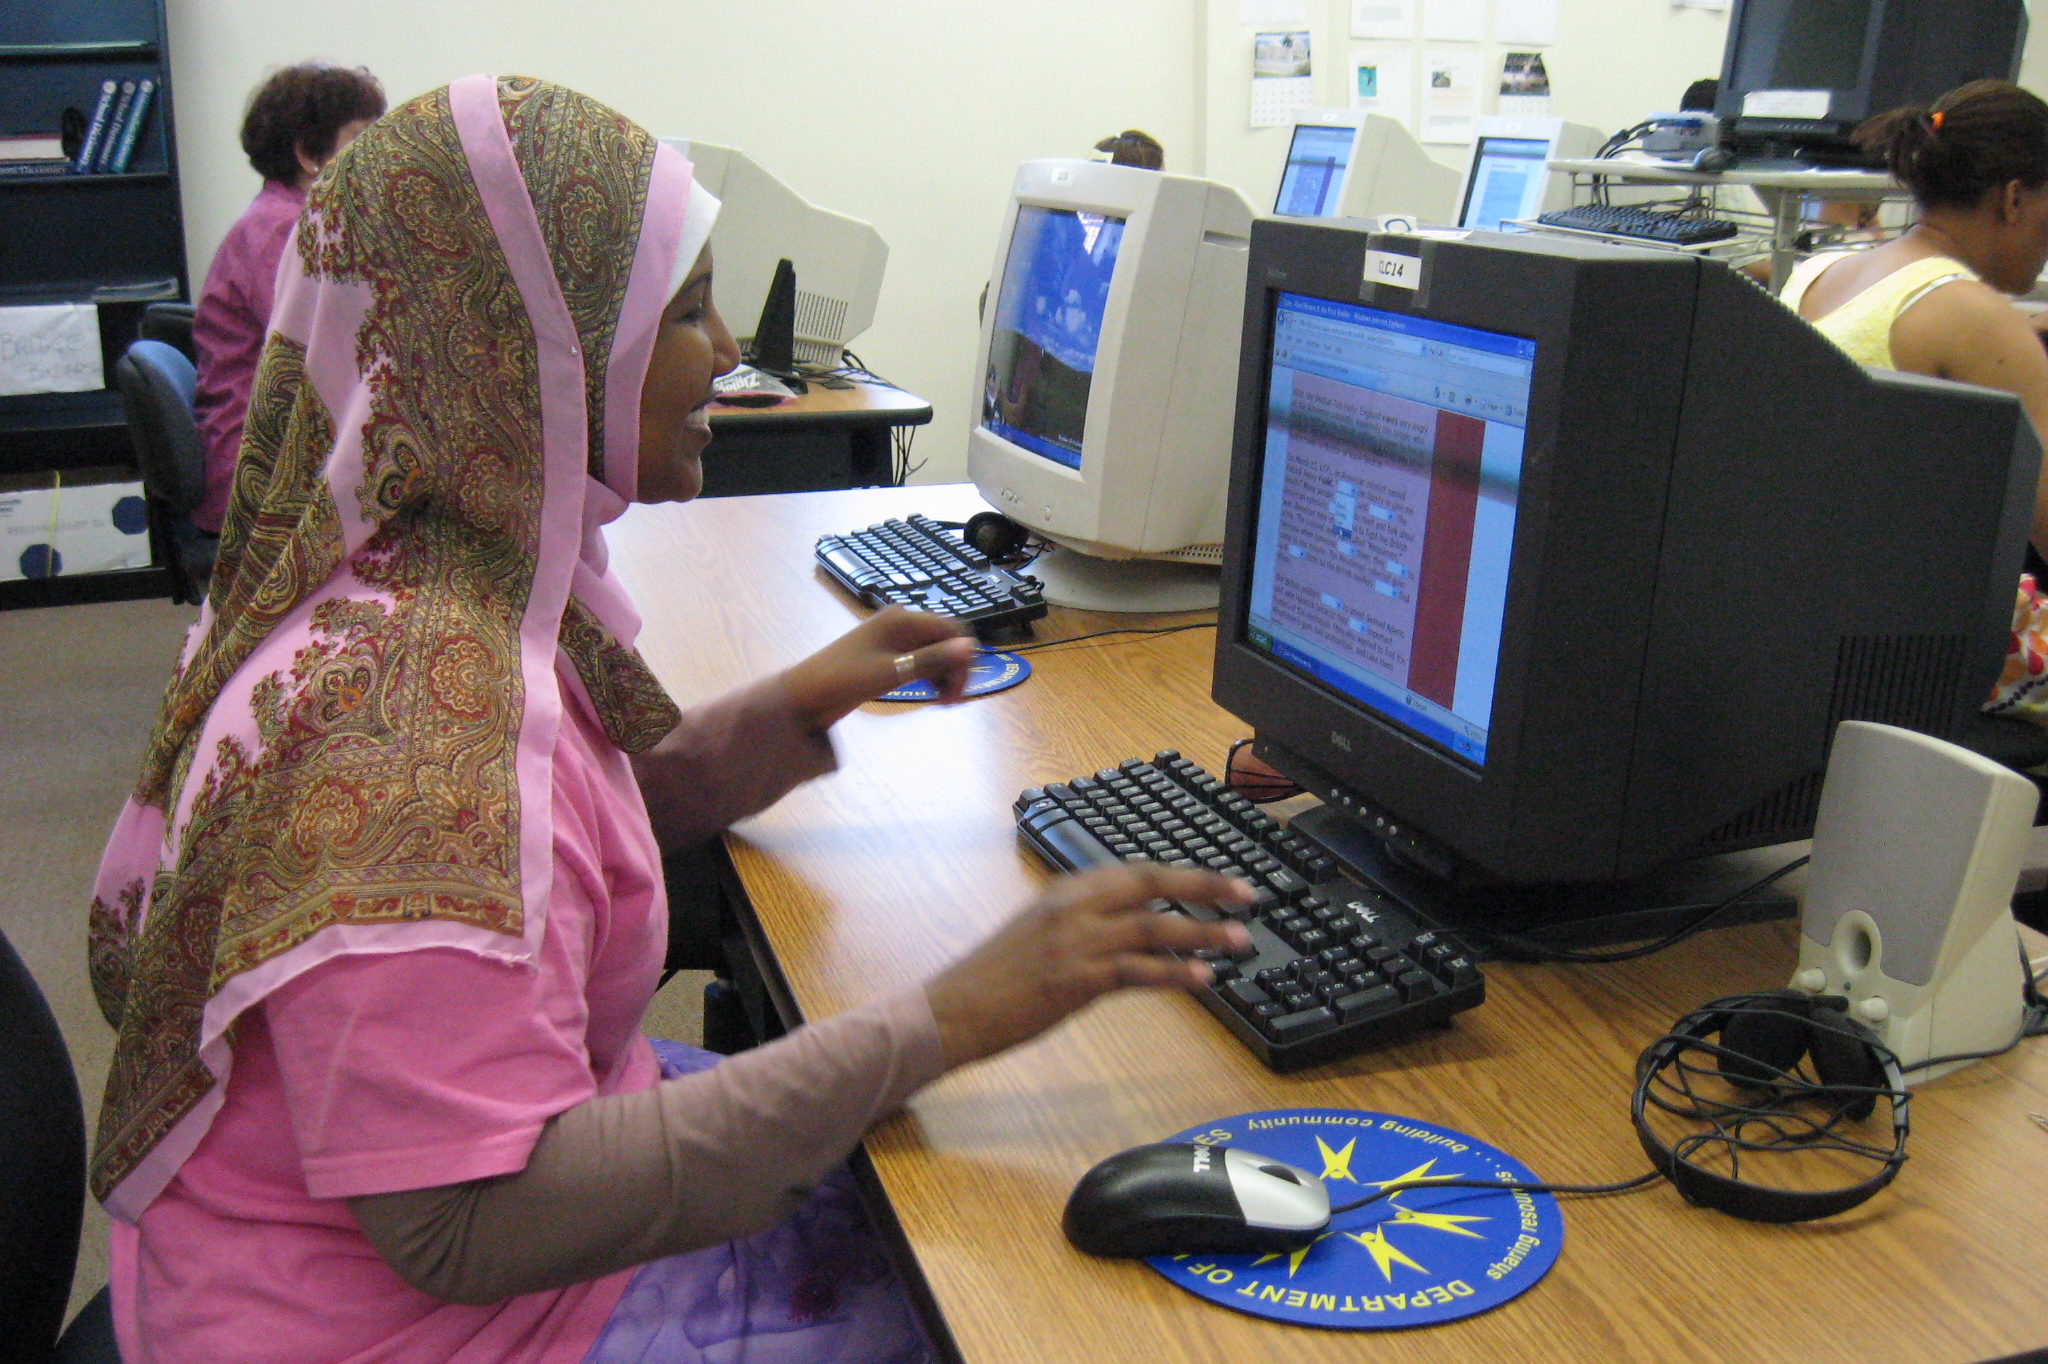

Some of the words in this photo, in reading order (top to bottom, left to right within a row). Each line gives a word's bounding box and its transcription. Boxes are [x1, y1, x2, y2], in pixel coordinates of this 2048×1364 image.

[1347, 901, 1380, 924] DELL
[1247, 1115, 1374, 1131] community
[1379, 1117, 1469, 1154] building
[1187, 1262, 1233, 1285] OF
[1236, 1278, 1476, 1313] DEPARTMENT
